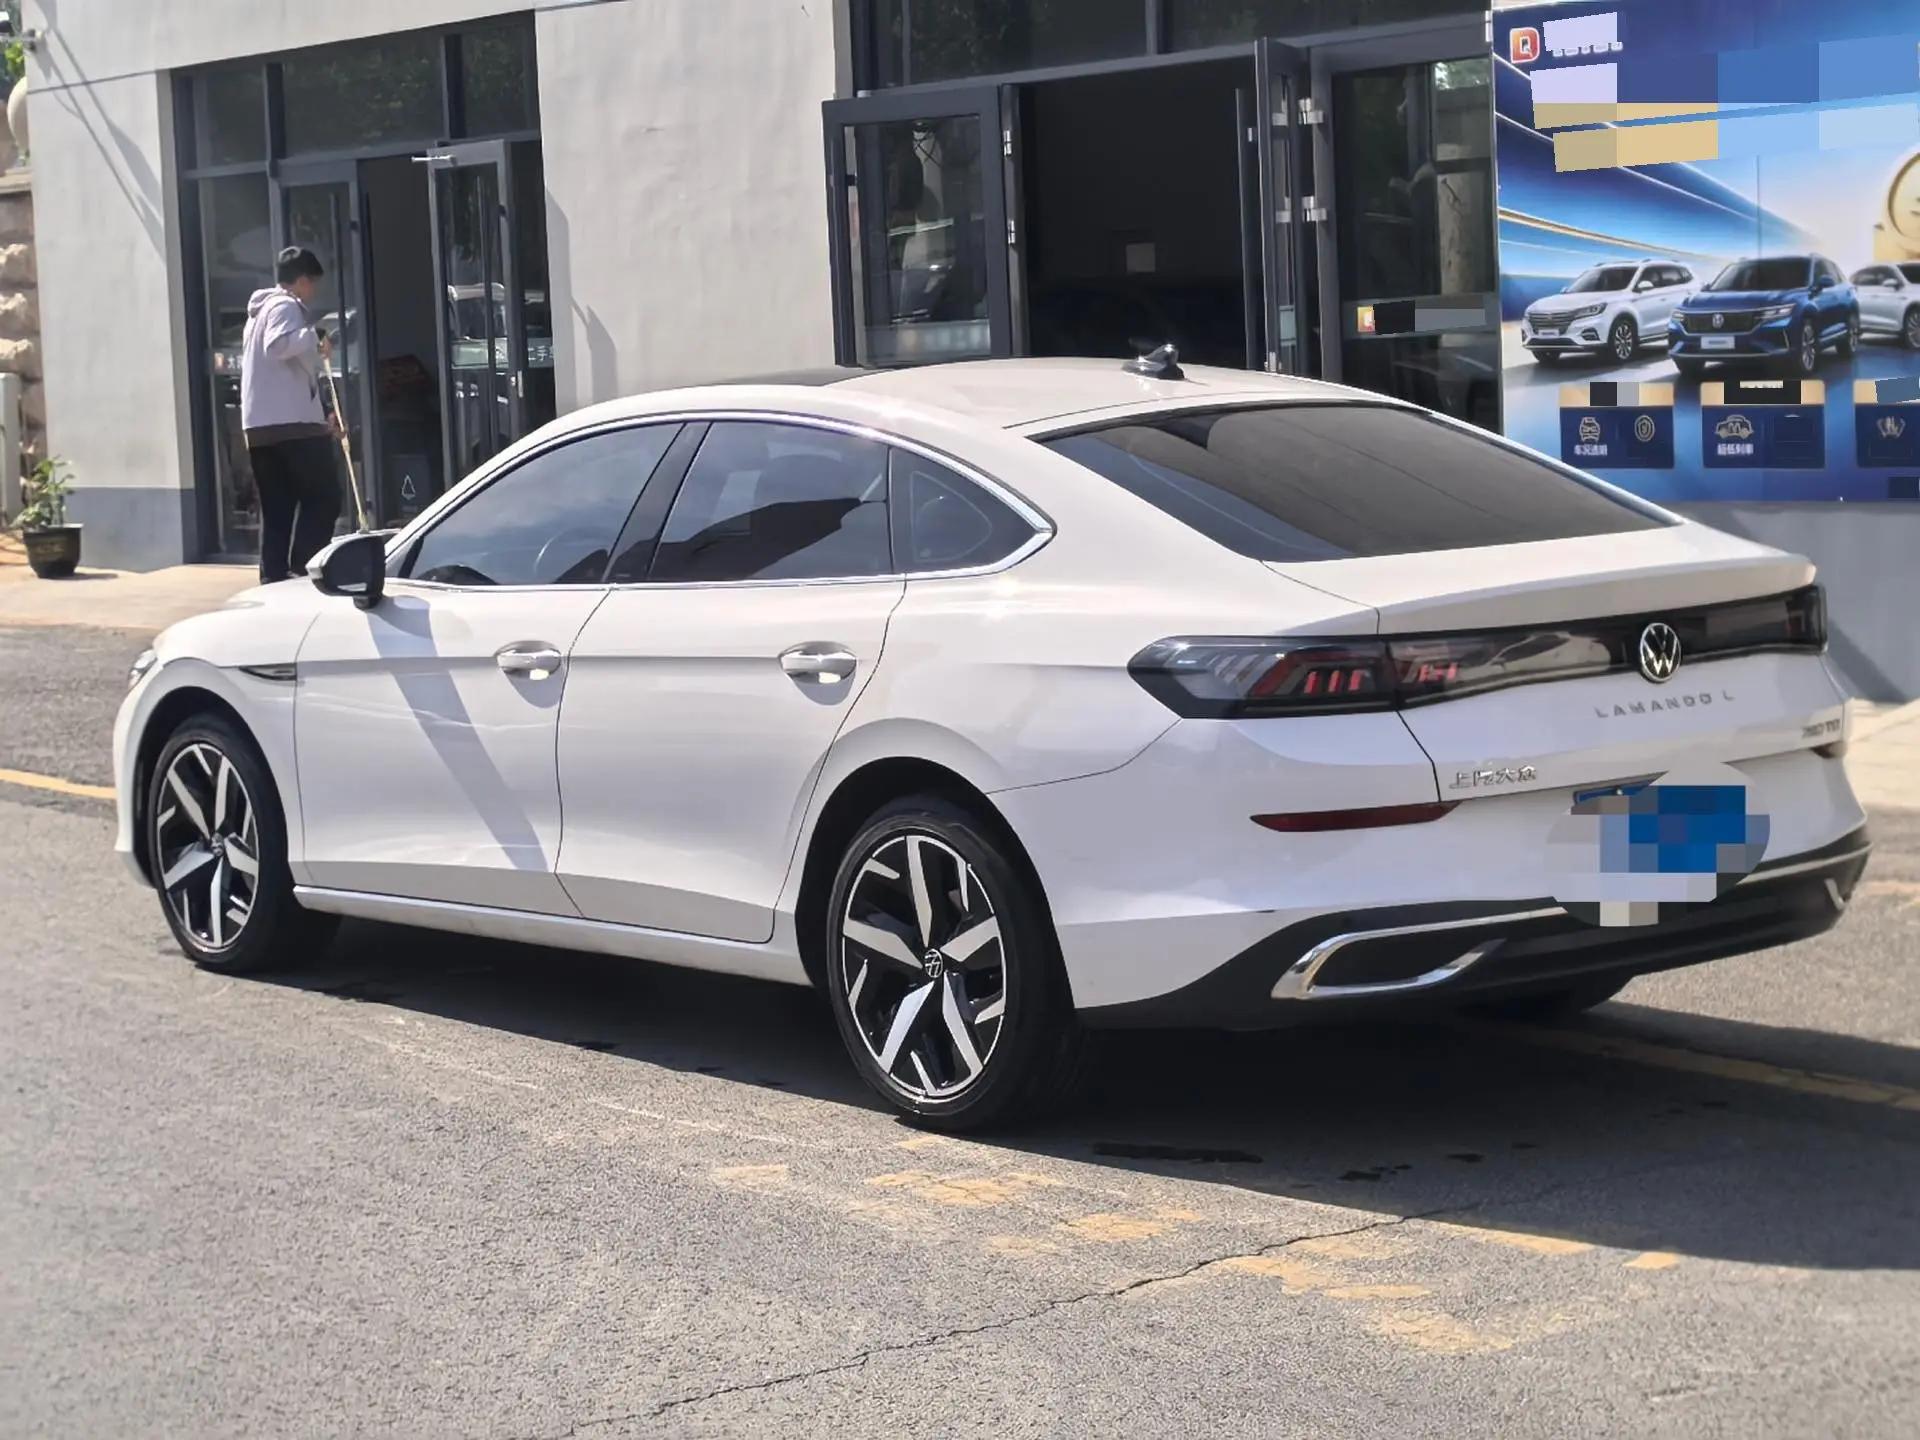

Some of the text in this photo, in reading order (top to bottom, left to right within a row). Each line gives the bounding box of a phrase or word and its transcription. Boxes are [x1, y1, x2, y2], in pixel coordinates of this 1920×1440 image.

[1594, 690, 1735, 718] LAMANDO L
[1449, 765, 1537, 789] 上汽大众
